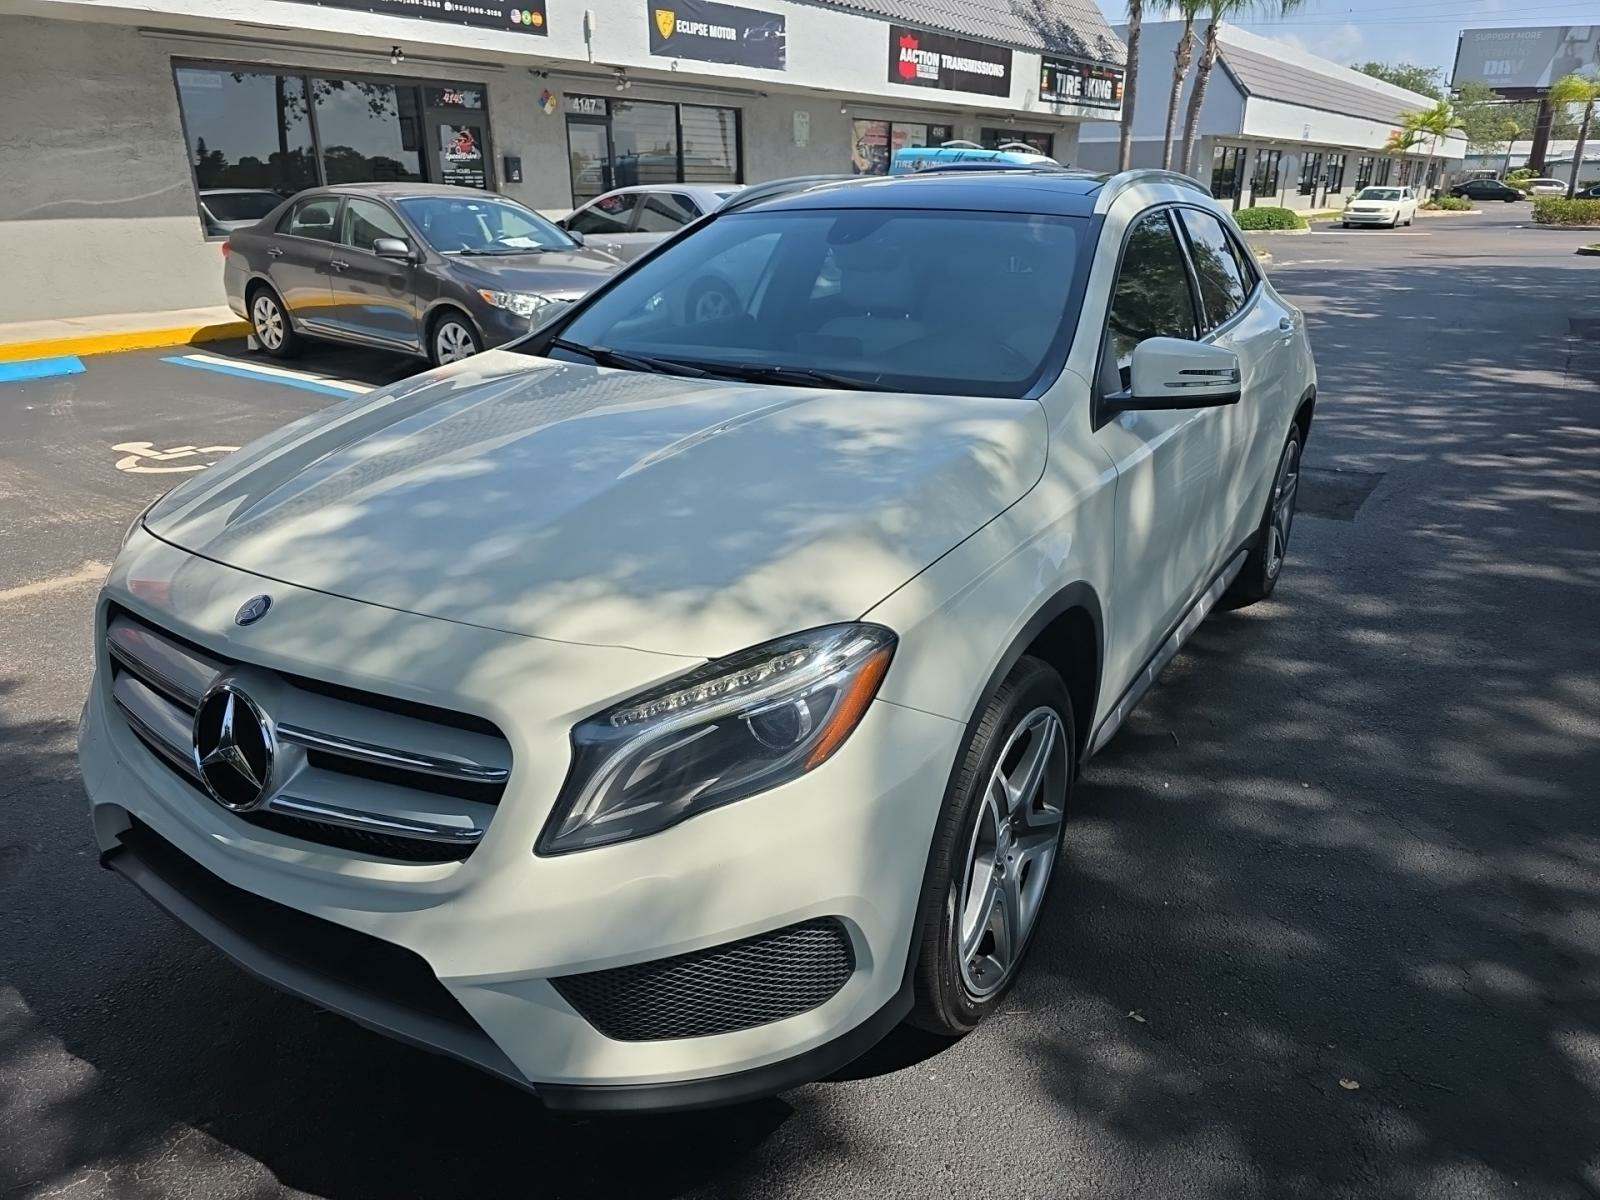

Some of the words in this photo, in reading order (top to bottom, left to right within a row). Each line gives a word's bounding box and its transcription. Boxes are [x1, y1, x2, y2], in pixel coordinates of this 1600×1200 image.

[676, 19, 709, 37] ECLIPSE
[709, 25, 737, 41] MOTOR
[1473, 32, 1515, 41] SUPPORT
[1516, 31, 1543, 40] MORE
[900, 47, 940, 67] AACTION
[941, 54, 1005, 78] TRANSMISSIONS
[1056, 73, 1082, 97] TIRE
[1088, 78, 1112, 100] KING
[573, 97, 596, 113] 4147
